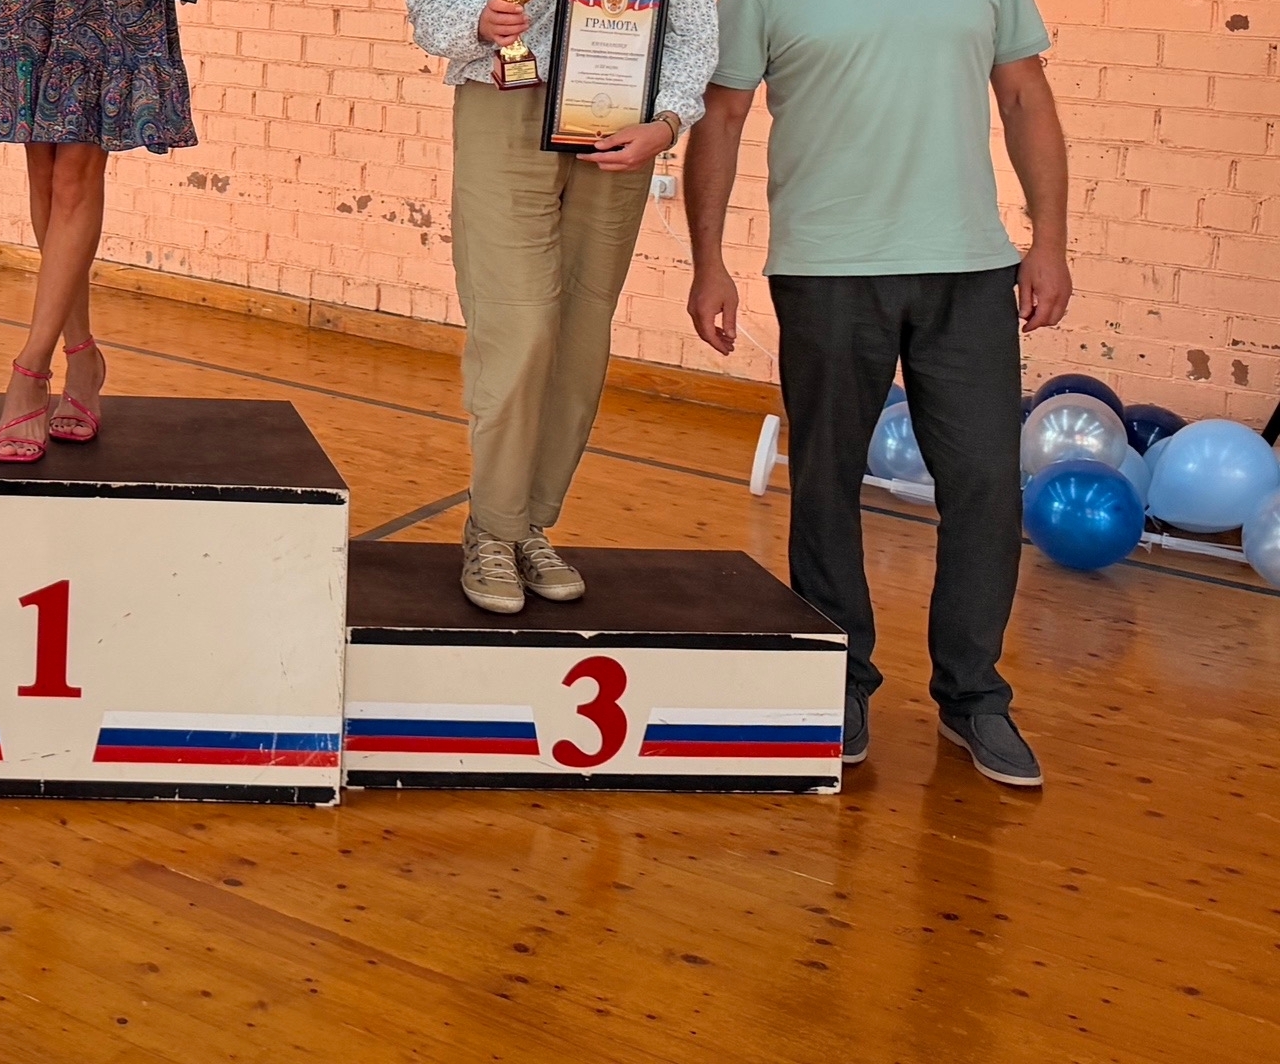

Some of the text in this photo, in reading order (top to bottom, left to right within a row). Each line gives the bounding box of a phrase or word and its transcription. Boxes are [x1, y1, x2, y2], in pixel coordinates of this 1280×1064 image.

[585, 17, 639, 32] ГРАМОТА
[17, 579, 82, 699] 1
[552, 655, 628, 768] 3
